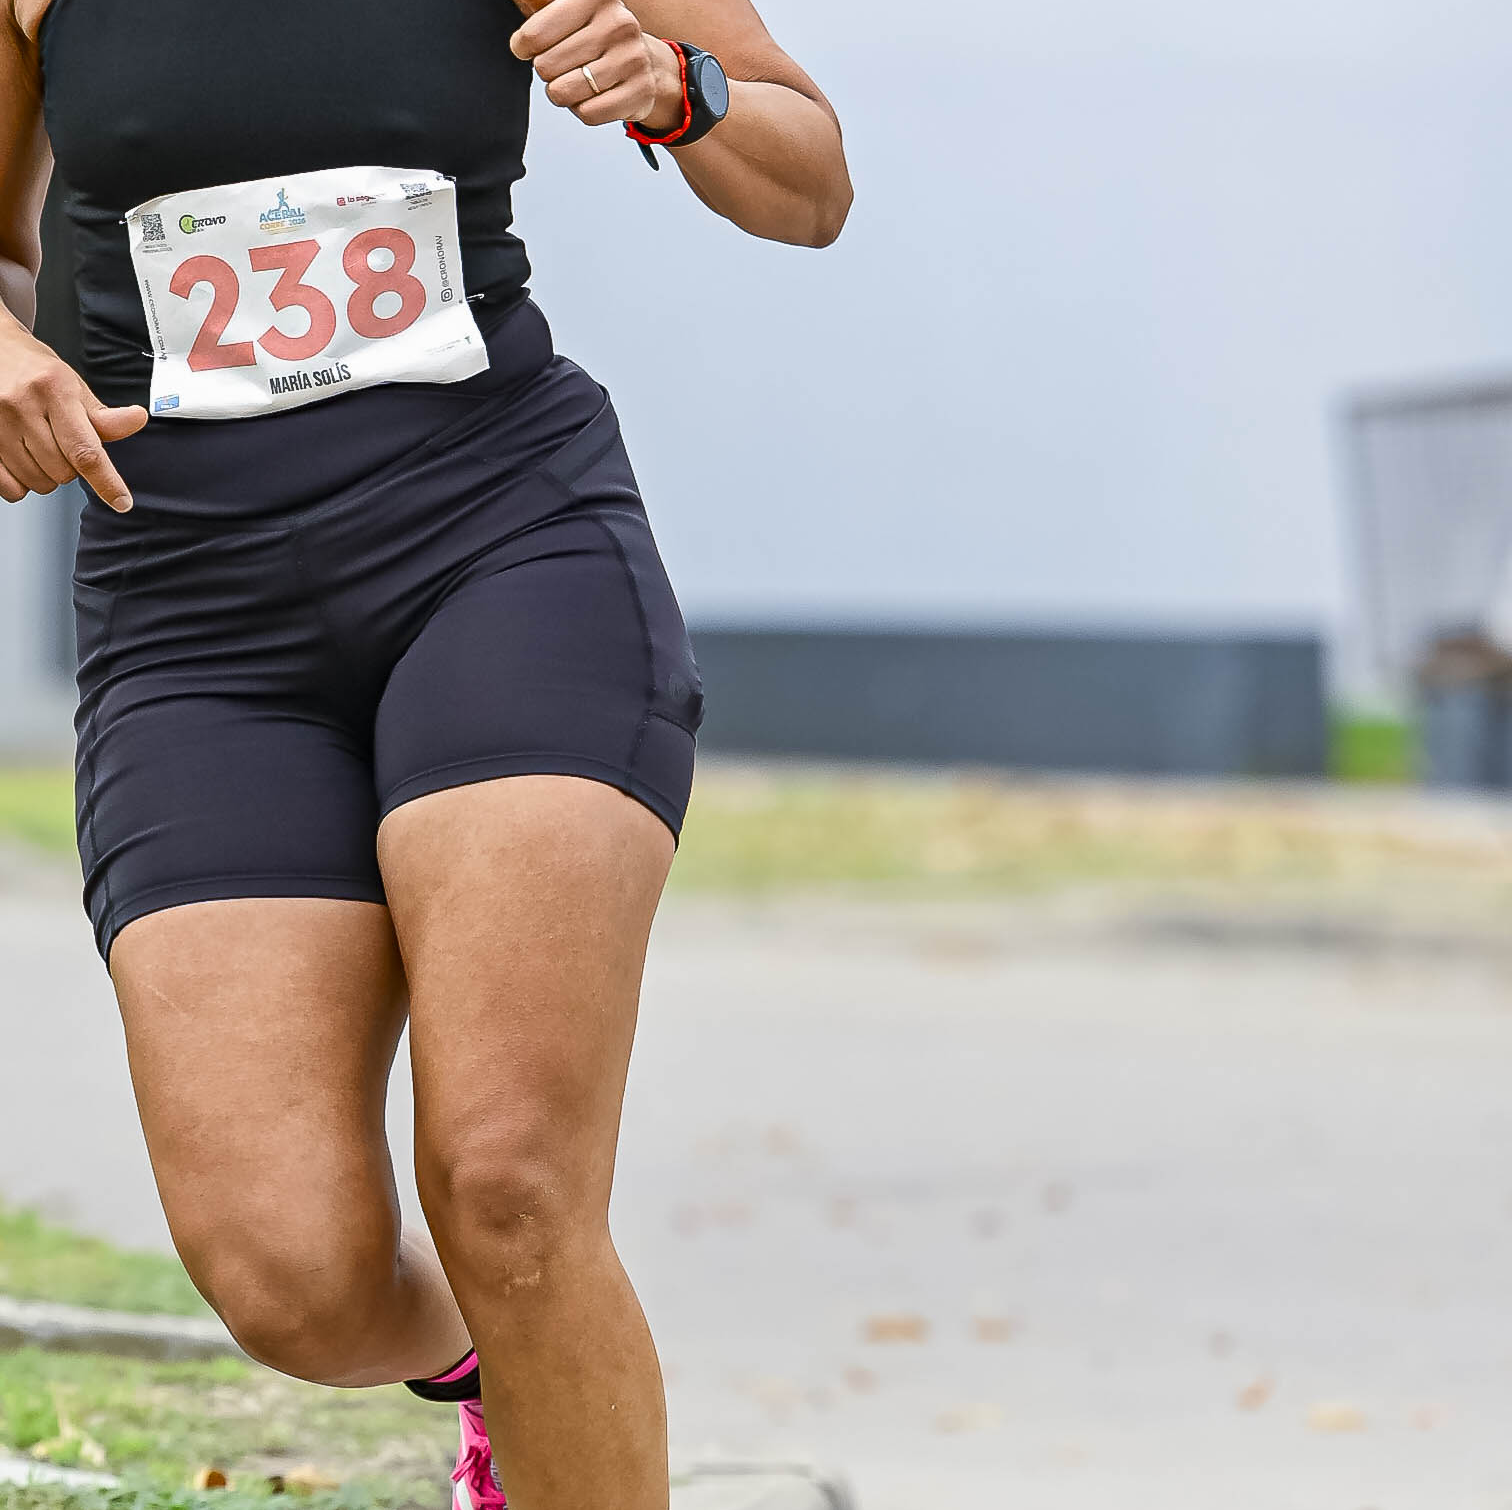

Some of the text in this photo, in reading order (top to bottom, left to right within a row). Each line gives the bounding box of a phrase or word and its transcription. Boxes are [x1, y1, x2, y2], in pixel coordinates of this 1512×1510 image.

[169, 227, 426, 372] 238
[269, 362, 351, 394] MARÍA SOLÍS
